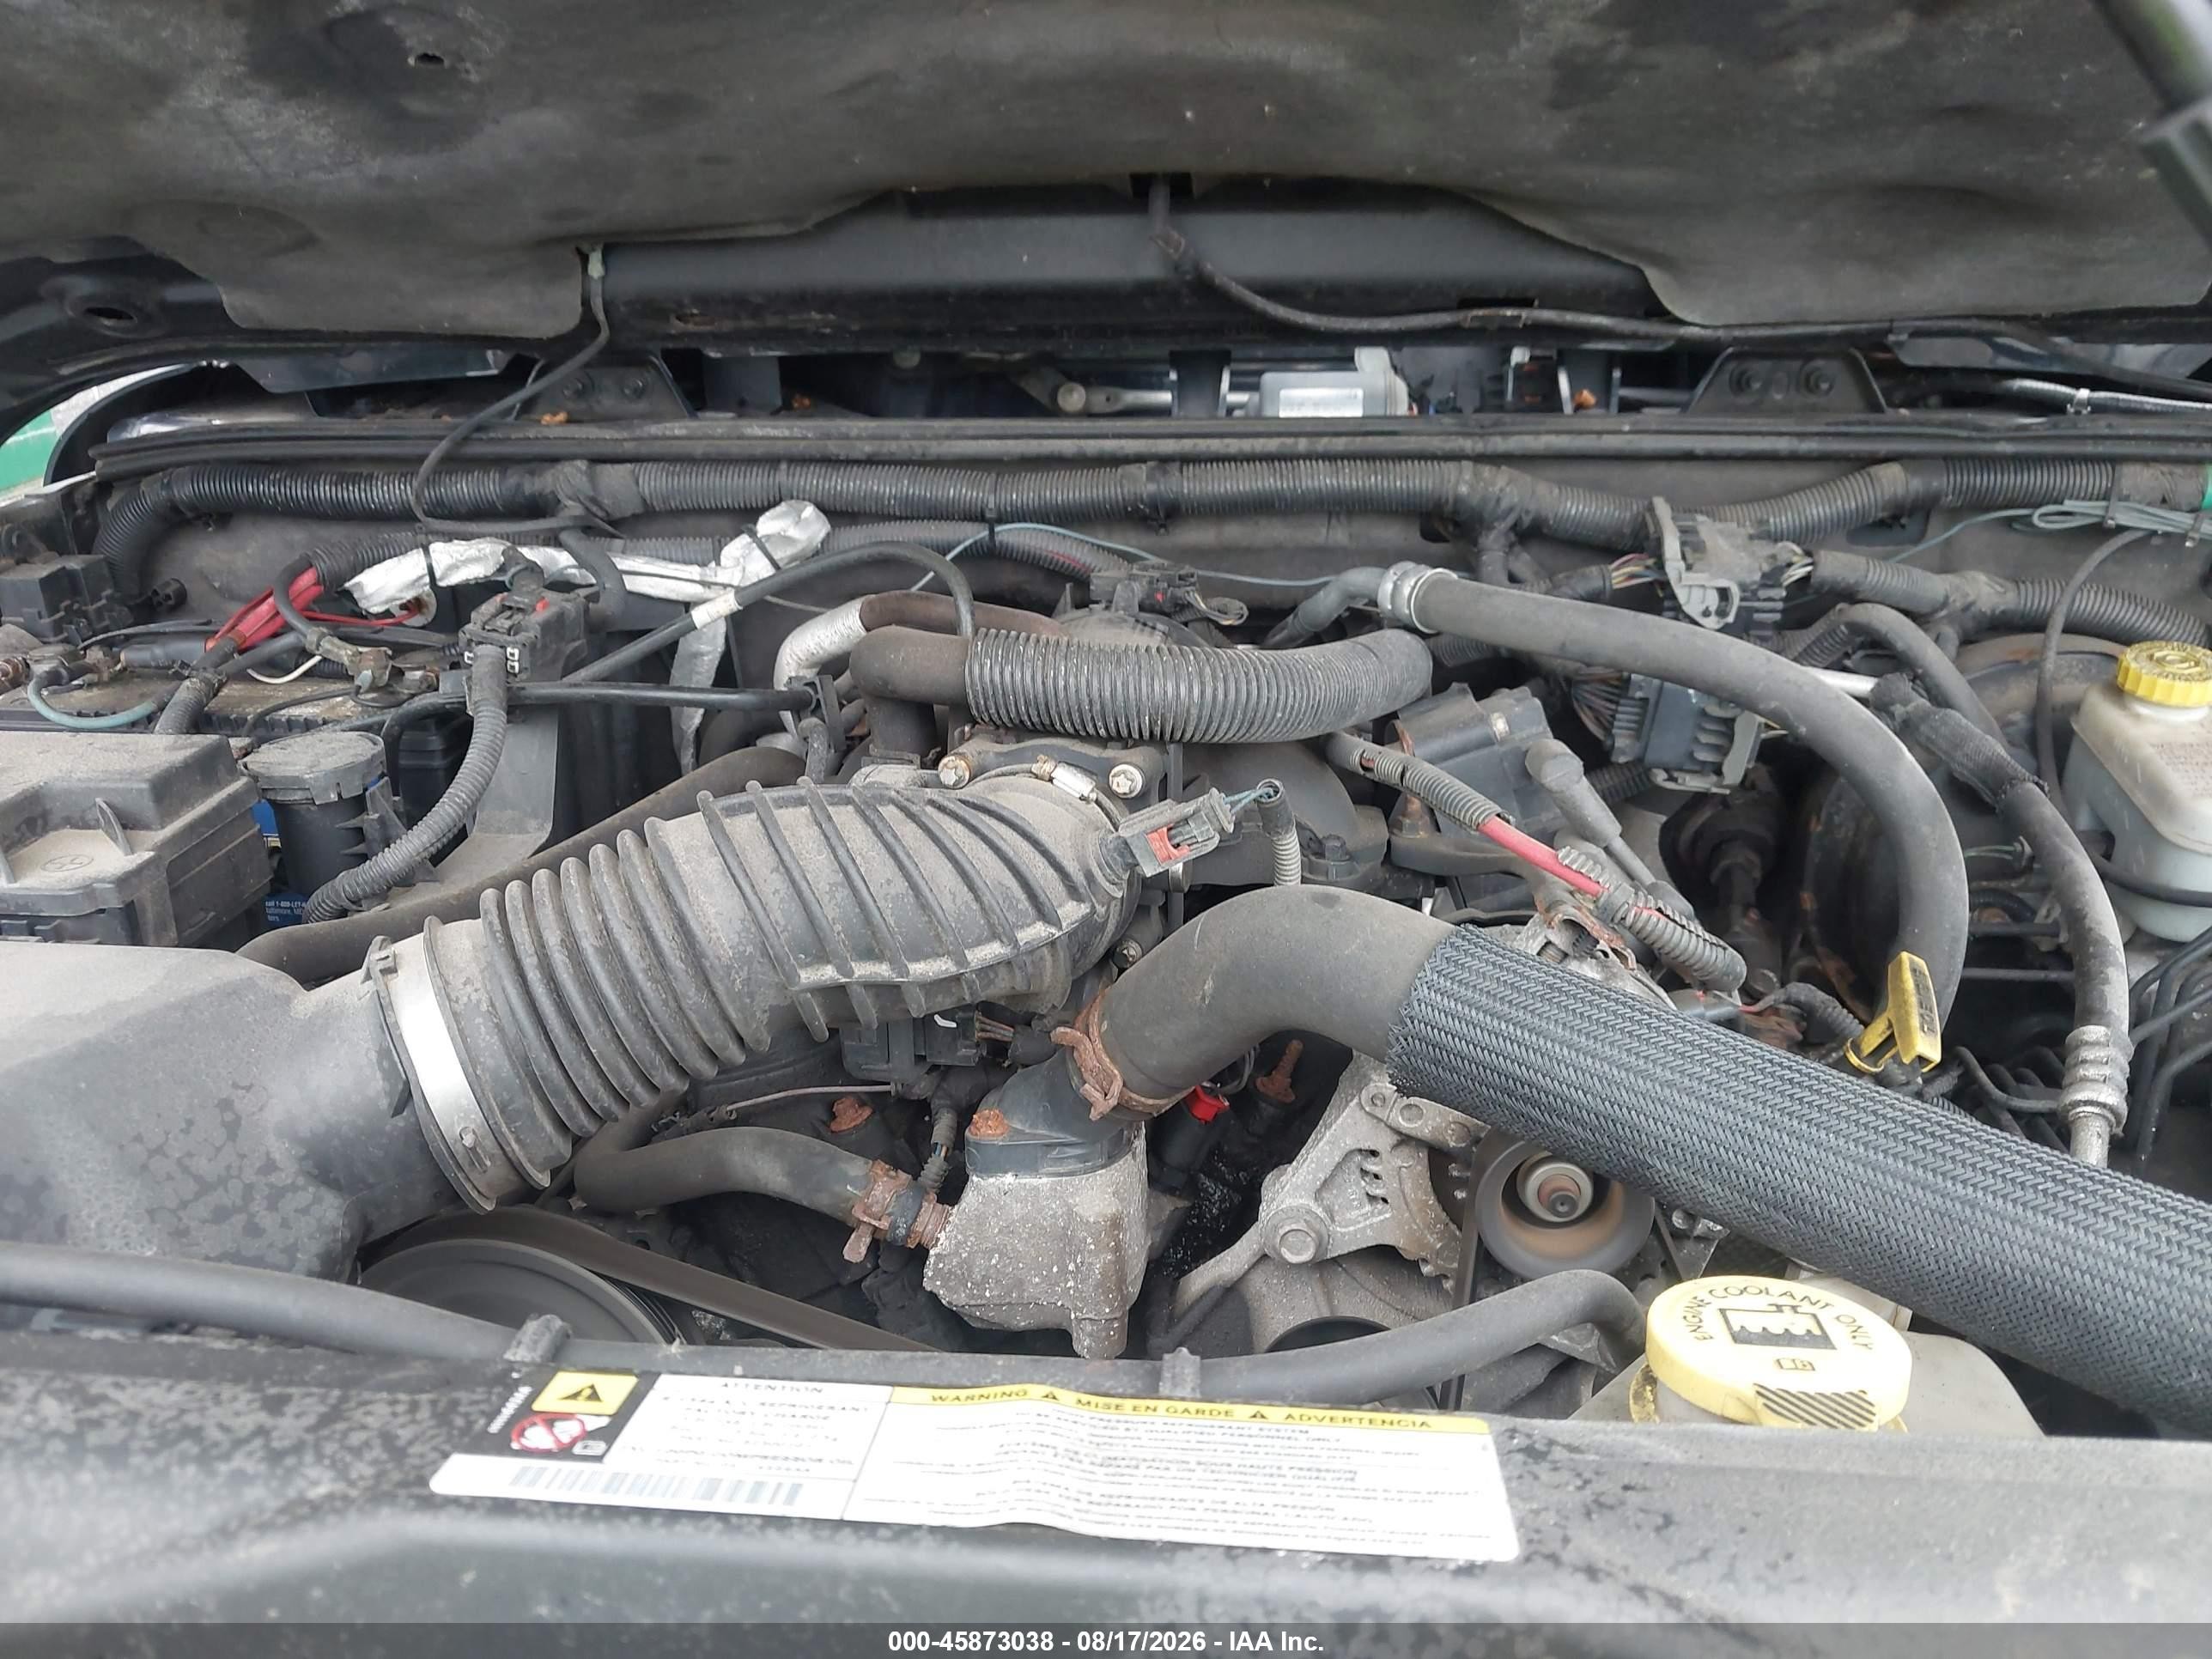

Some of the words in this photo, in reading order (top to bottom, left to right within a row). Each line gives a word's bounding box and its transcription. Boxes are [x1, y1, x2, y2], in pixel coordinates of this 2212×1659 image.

[1682, 1296, 1714, 1342] ENGINE
[1709, 1285, 1835, 1310] COOLANT
[1834, 1314, 1874, 1351] ONLY
[932, 1389, 1029, 1402] WARNING
[1076, 1397, 1127, 1411] MISE
[1131, 1403, 1158, 1413] EN
[1164, 1405, 1236, 1418] GARDE
[1284, 1413, 1432, 1429] ADVERTENCIA
